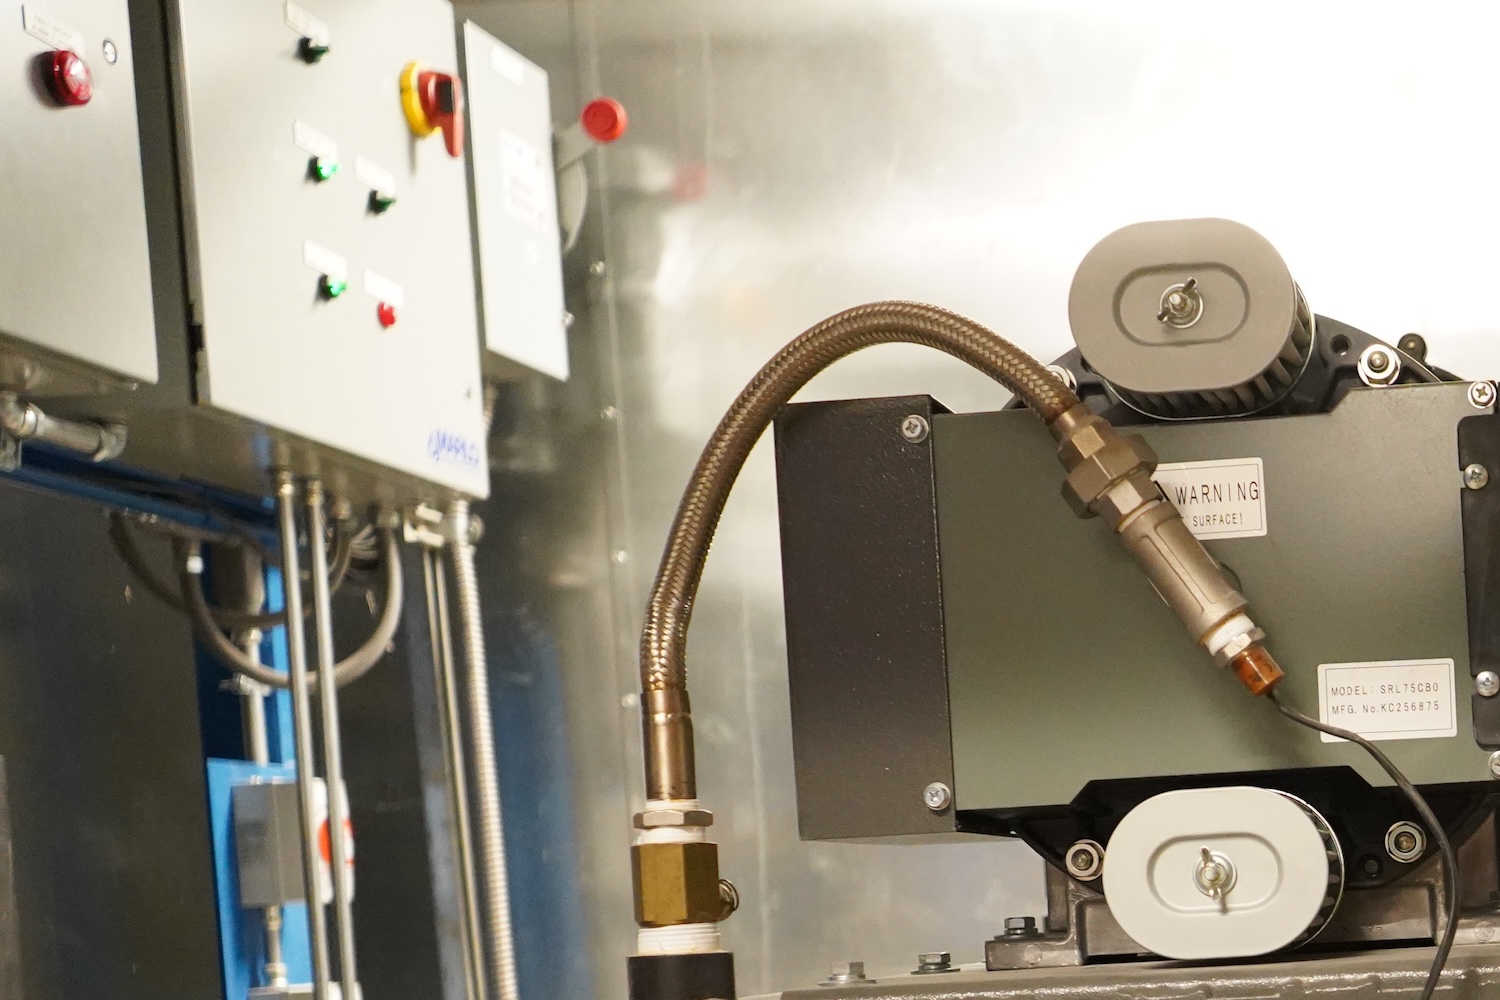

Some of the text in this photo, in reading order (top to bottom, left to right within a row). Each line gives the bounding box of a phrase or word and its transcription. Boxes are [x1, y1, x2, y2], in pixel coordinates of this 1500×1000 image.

[1175, 481, 1259, 505] WARNING
[1193, 513, 1243, 527] SURFACE!
[1331, 685, 1374, 696] MODEL:
[1332, 704, 1357, 714] MFG.
